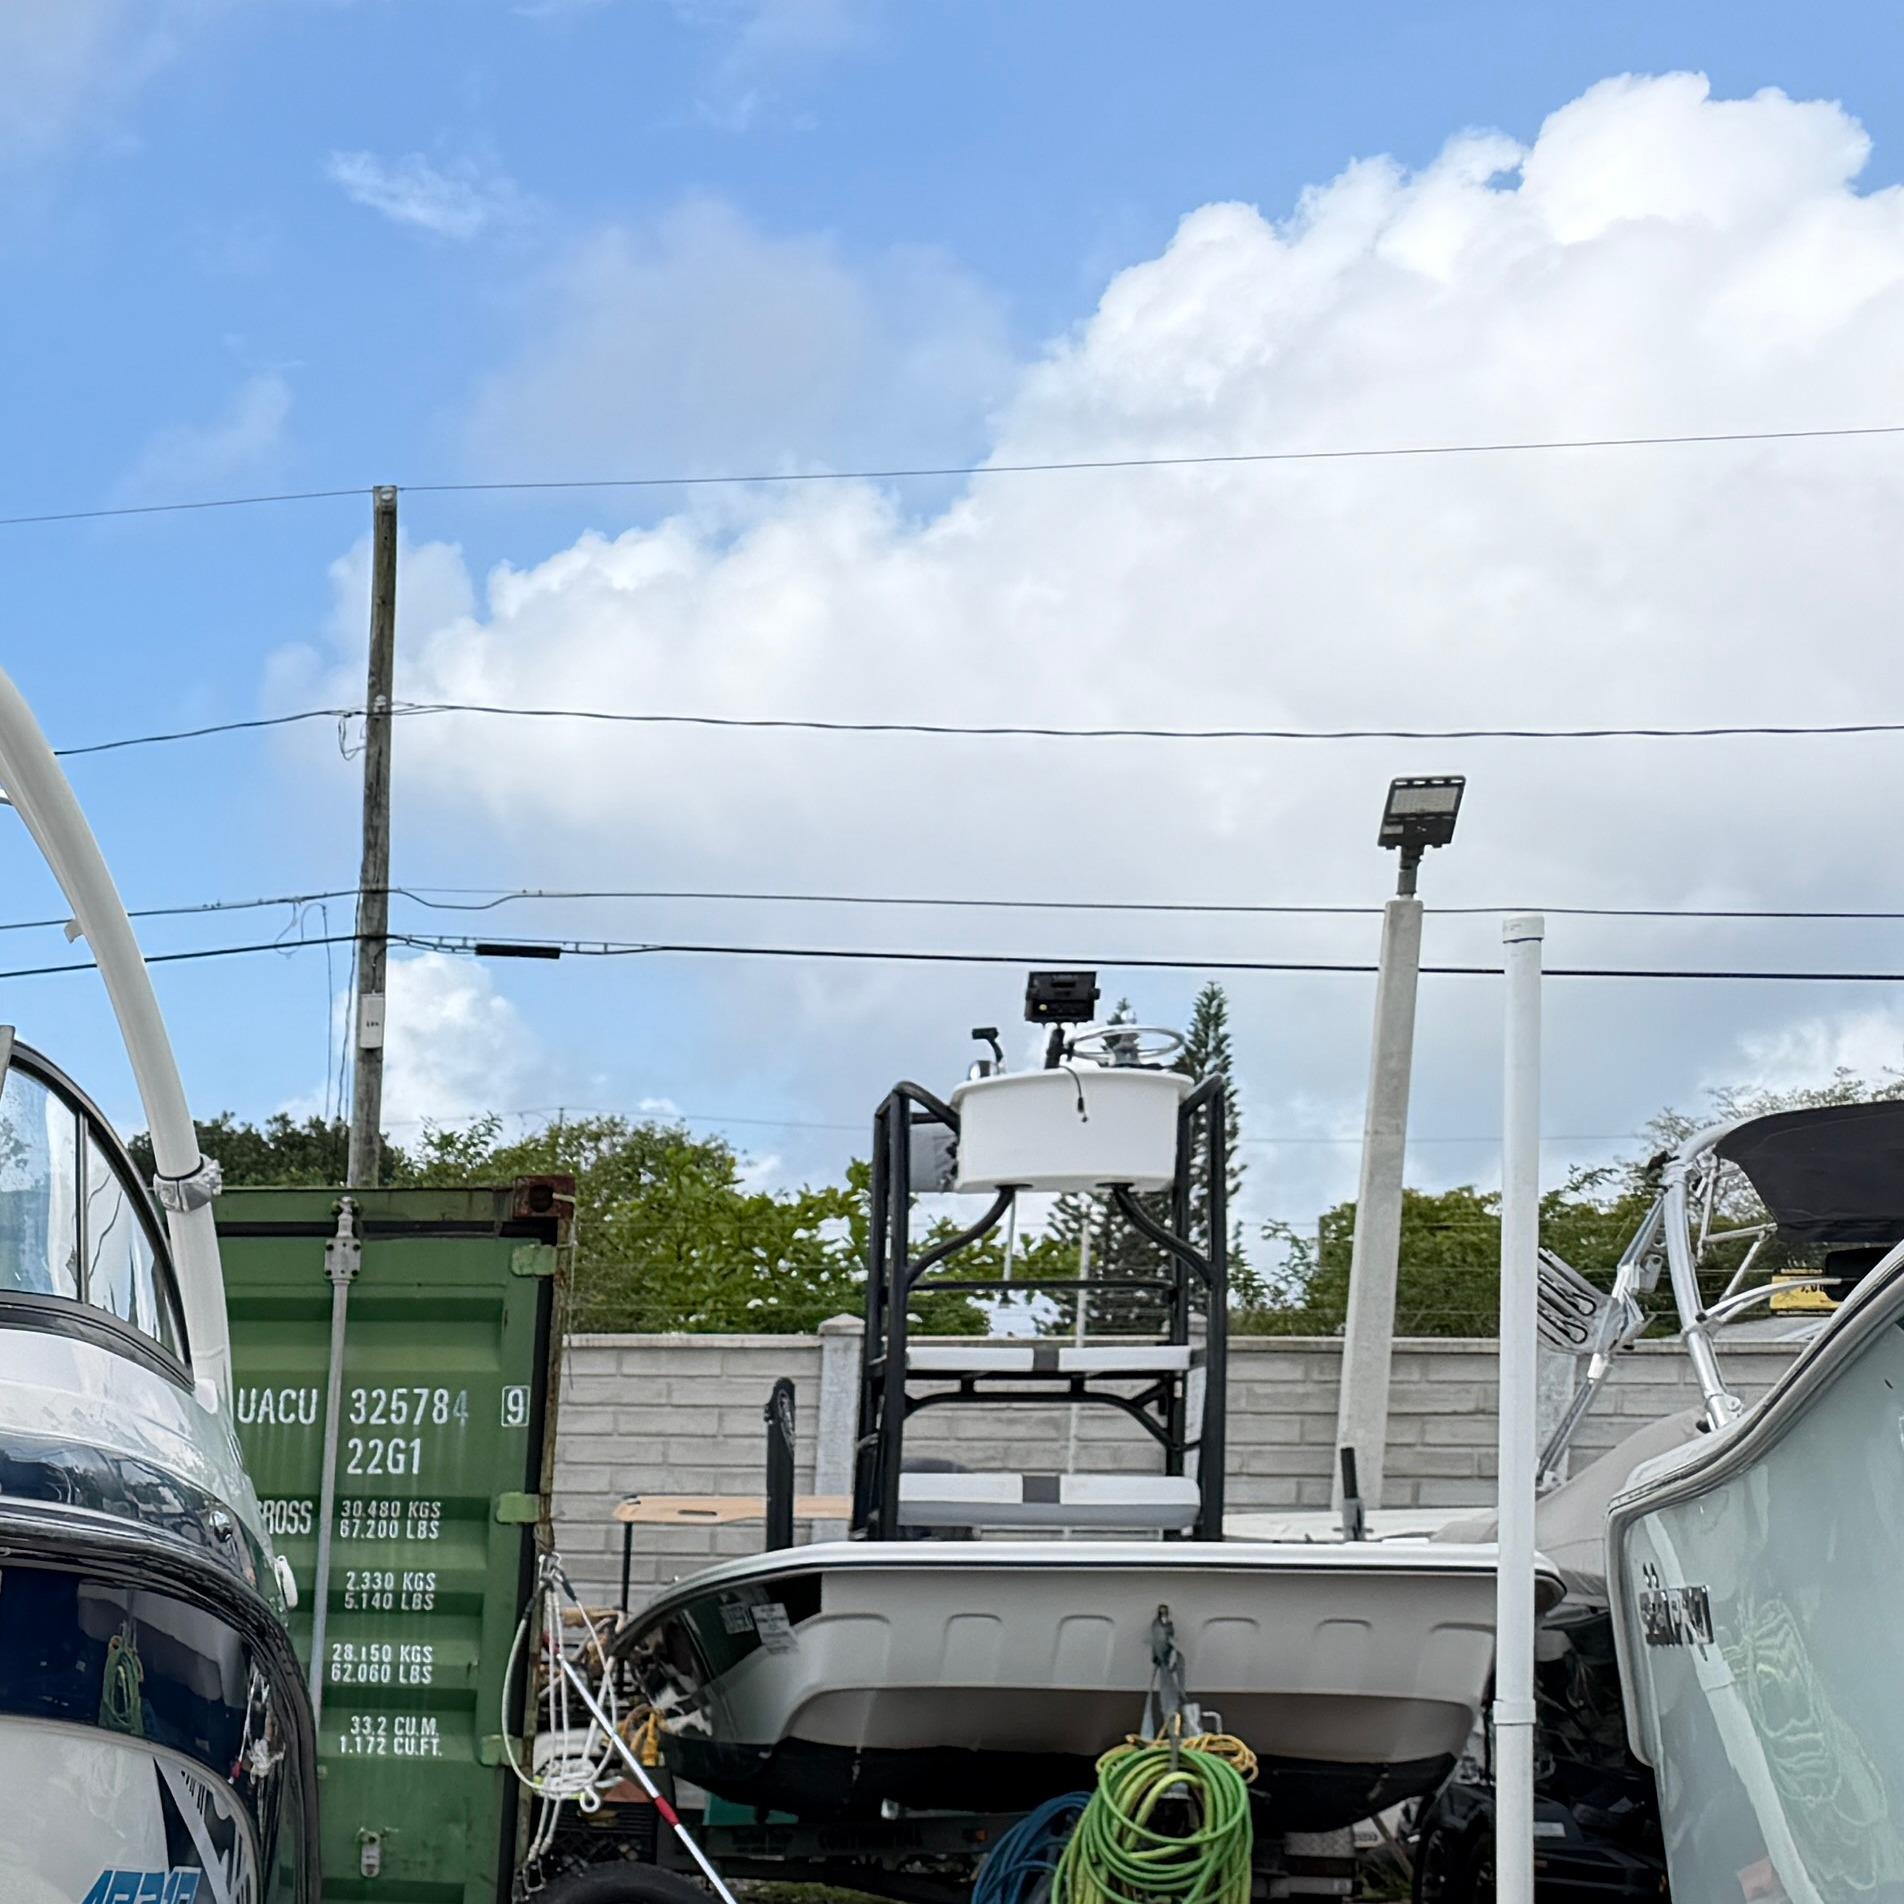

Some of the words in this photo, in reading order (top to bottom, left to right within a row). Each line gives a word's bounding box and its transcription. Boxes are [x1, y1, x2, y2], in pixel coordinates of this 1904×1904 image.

[237, 1388, 318, 1425] UACU
[349, 1388, 469, 1425] 325784
[506, 1389, 525, 1424] 9
[347, 1438, 422, 1475] 22G1
[257, 1500, 313, 1535] ROSS
[340, 1500, 401, 1518] 30.480
[408, 1501, 441, 1519] KGS
[339, 1519, 398, 1539] 67.200
[406, 1520, 440, 1540] LBS
[345, 1571, 395, 1591] 2.330
[402, 1572, 437, 1592] KGS
[344, 1592, 393, 1611] 5.140
[400, 1593, 435, 1611] LBS
[332, 1643, 392, 1663] 28.150
[400, 1645, 433, 1663] KGS
[331, 1663, 391, 1683] 62.060
[399, 1664, 433, 1684] LBS
[350, 1716, 387, 1736] 33.2
[340, 1735, 387, 1755] 1.172
